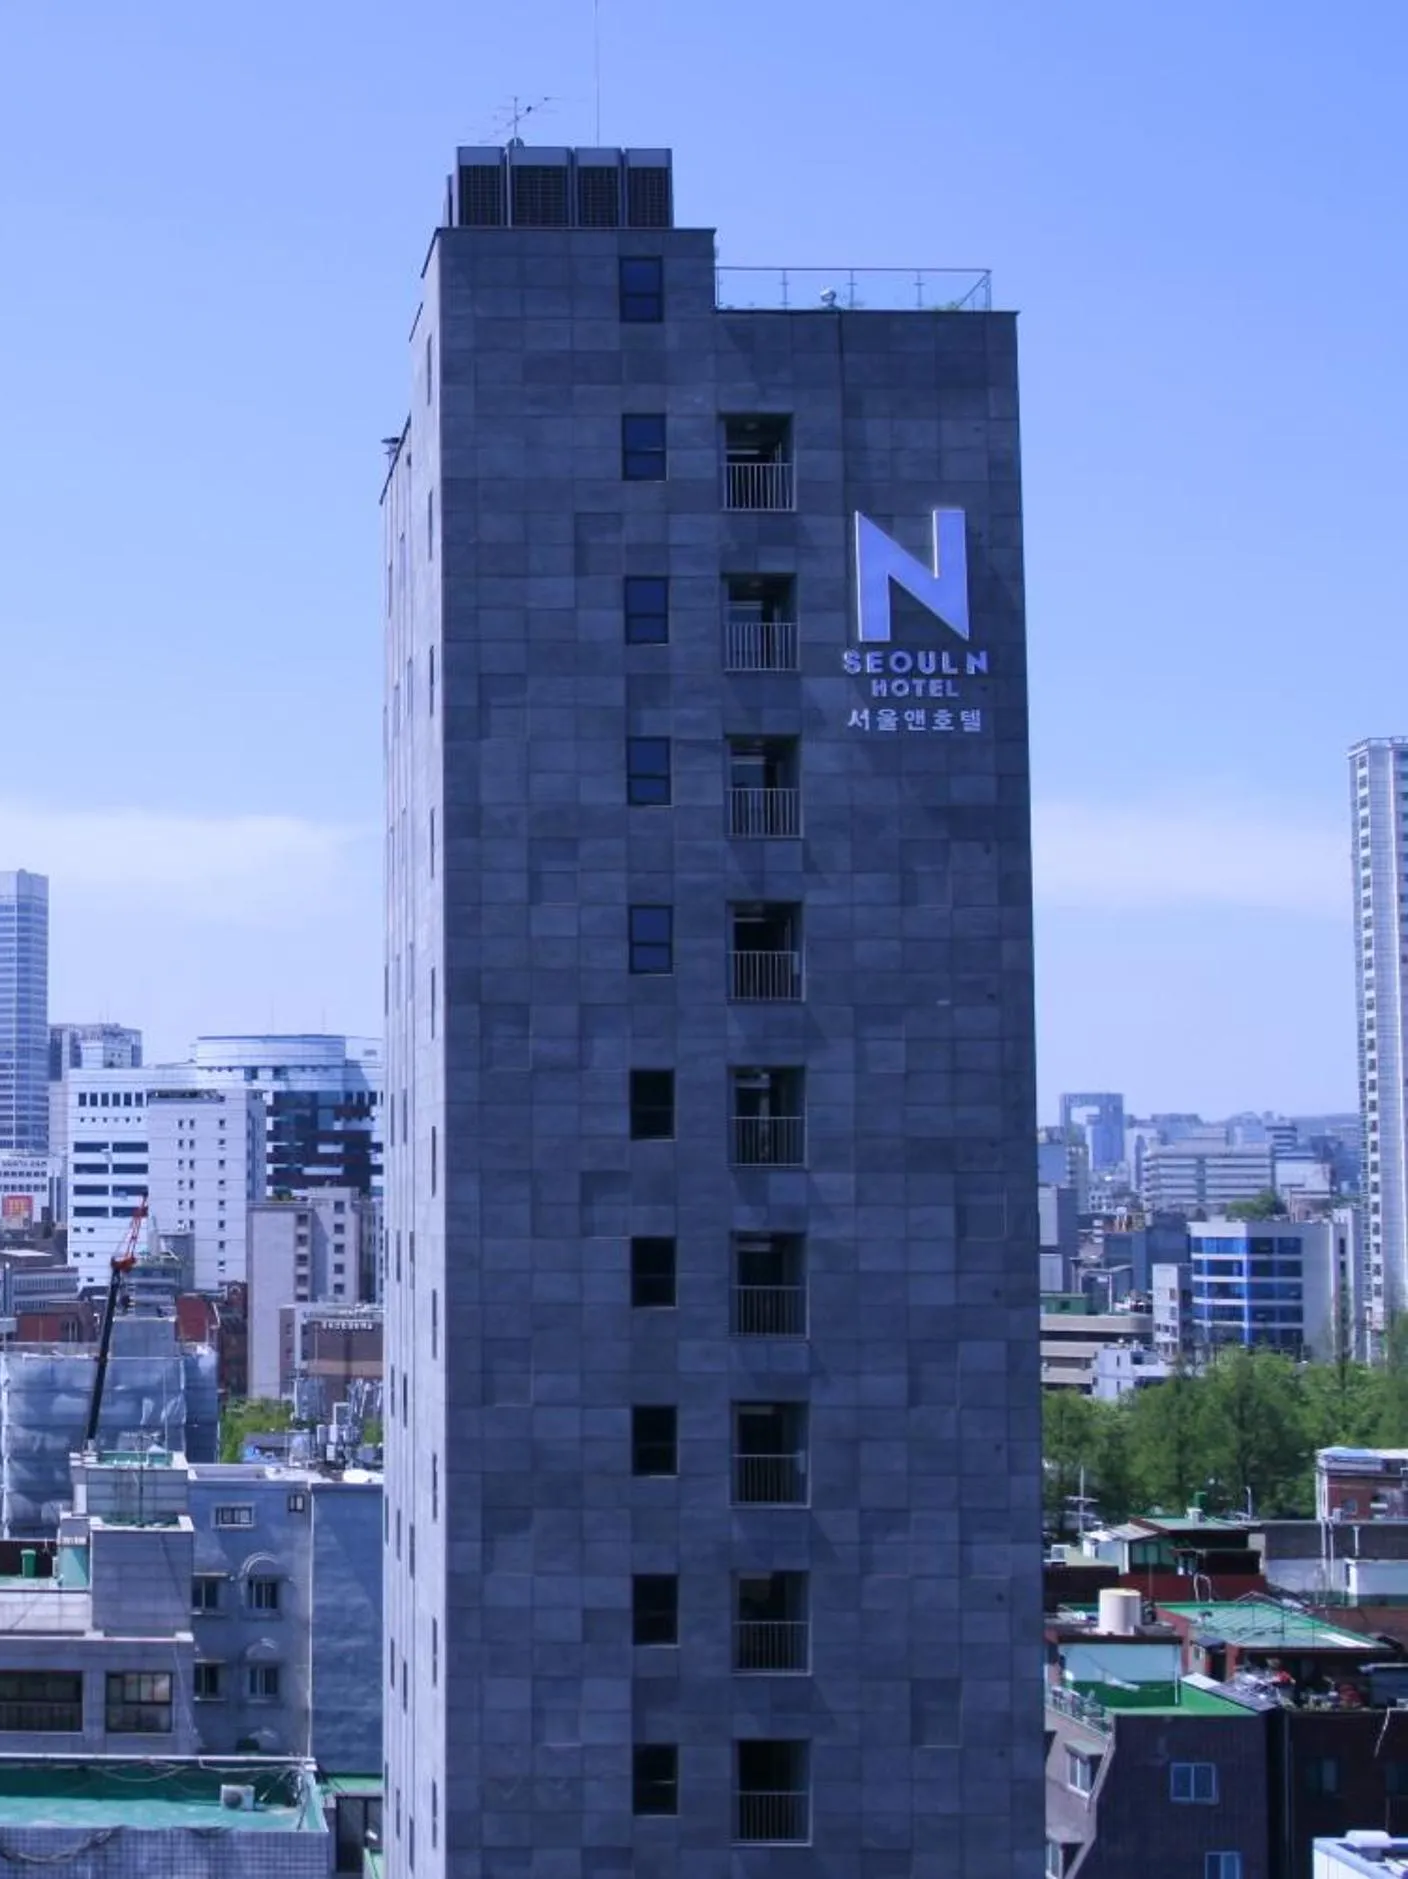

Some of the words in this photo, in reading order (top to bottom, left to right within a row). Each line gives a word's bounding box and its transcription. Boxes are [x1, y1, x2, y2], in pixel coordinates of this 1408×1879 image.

[855, 508, 970, 642] N
[843, 651, 958, 675] SEOUL
[966, 651, 988, 675] N
[871, 679, 960, 698] HOTEL
[847, 707, 982, 732] 서울앤호텔
